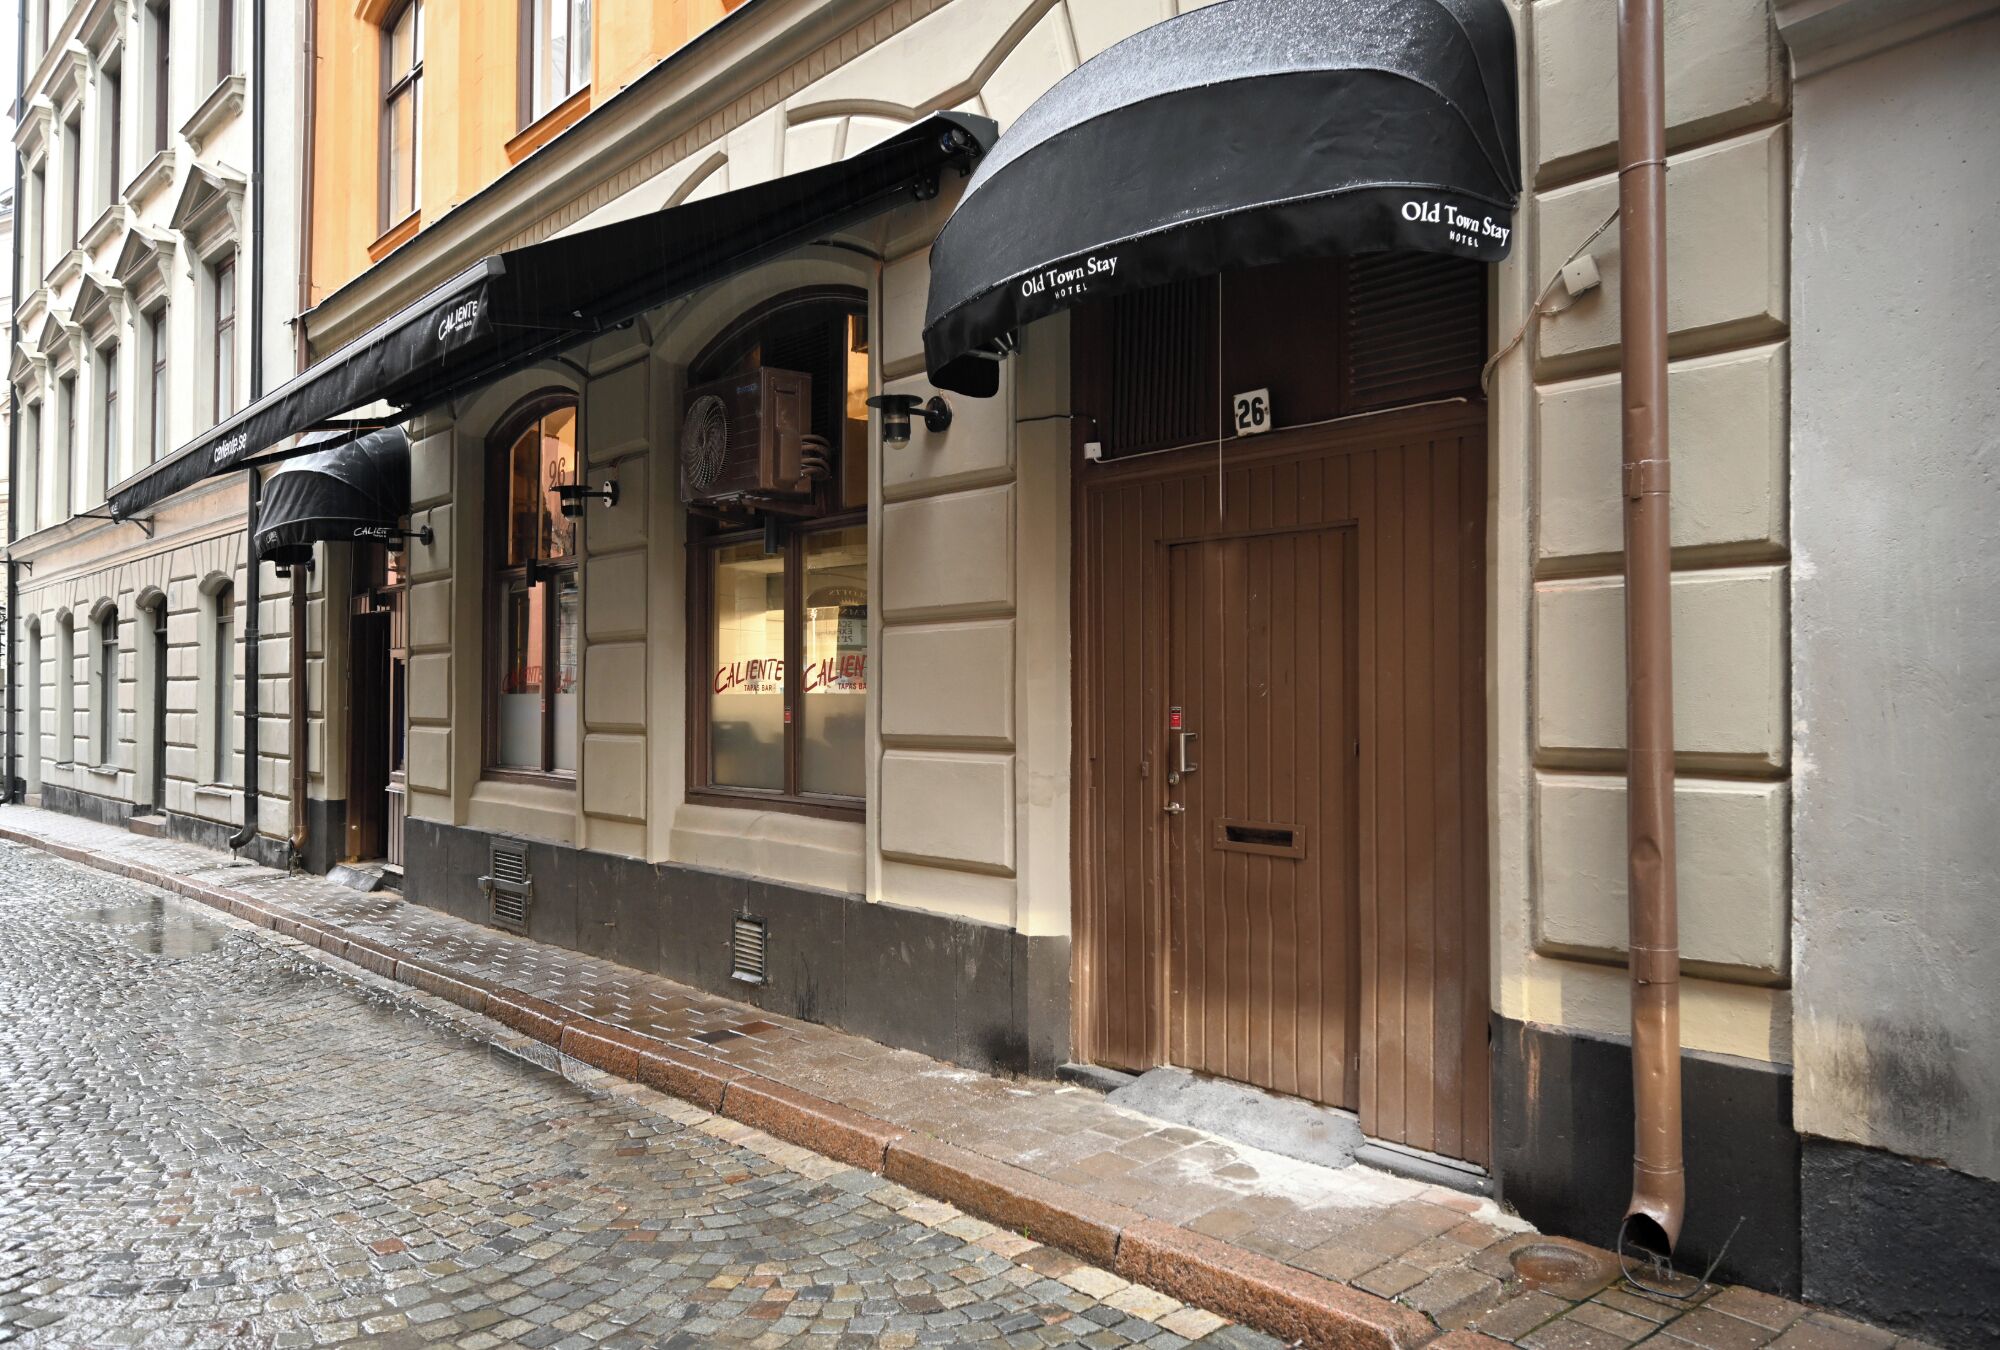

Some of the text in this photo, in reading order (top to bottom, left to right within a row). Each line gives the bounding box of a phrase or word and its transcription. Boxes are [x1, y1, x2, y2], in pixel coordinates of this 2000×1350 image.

[1401, 201, 1510, 247] Old Town Stay
[1449, 230, 1479, 248] HOTEL
[1022, 256, 1118, 297] Old Town Stay
[1054, 282, 1088, 299] HOTEL
[438, 300, 478, 341] CALIENTE
[1237, 396, 1265, 430] 26
[213, 432, 248, 463] caliente.se
[714, 658, 785, 694] CALIENTE
[743, 684, 760, 692] TAPAS
[802, 654, 868, 693] CALIEN
[838, 682, 857, 690] TAPAS
